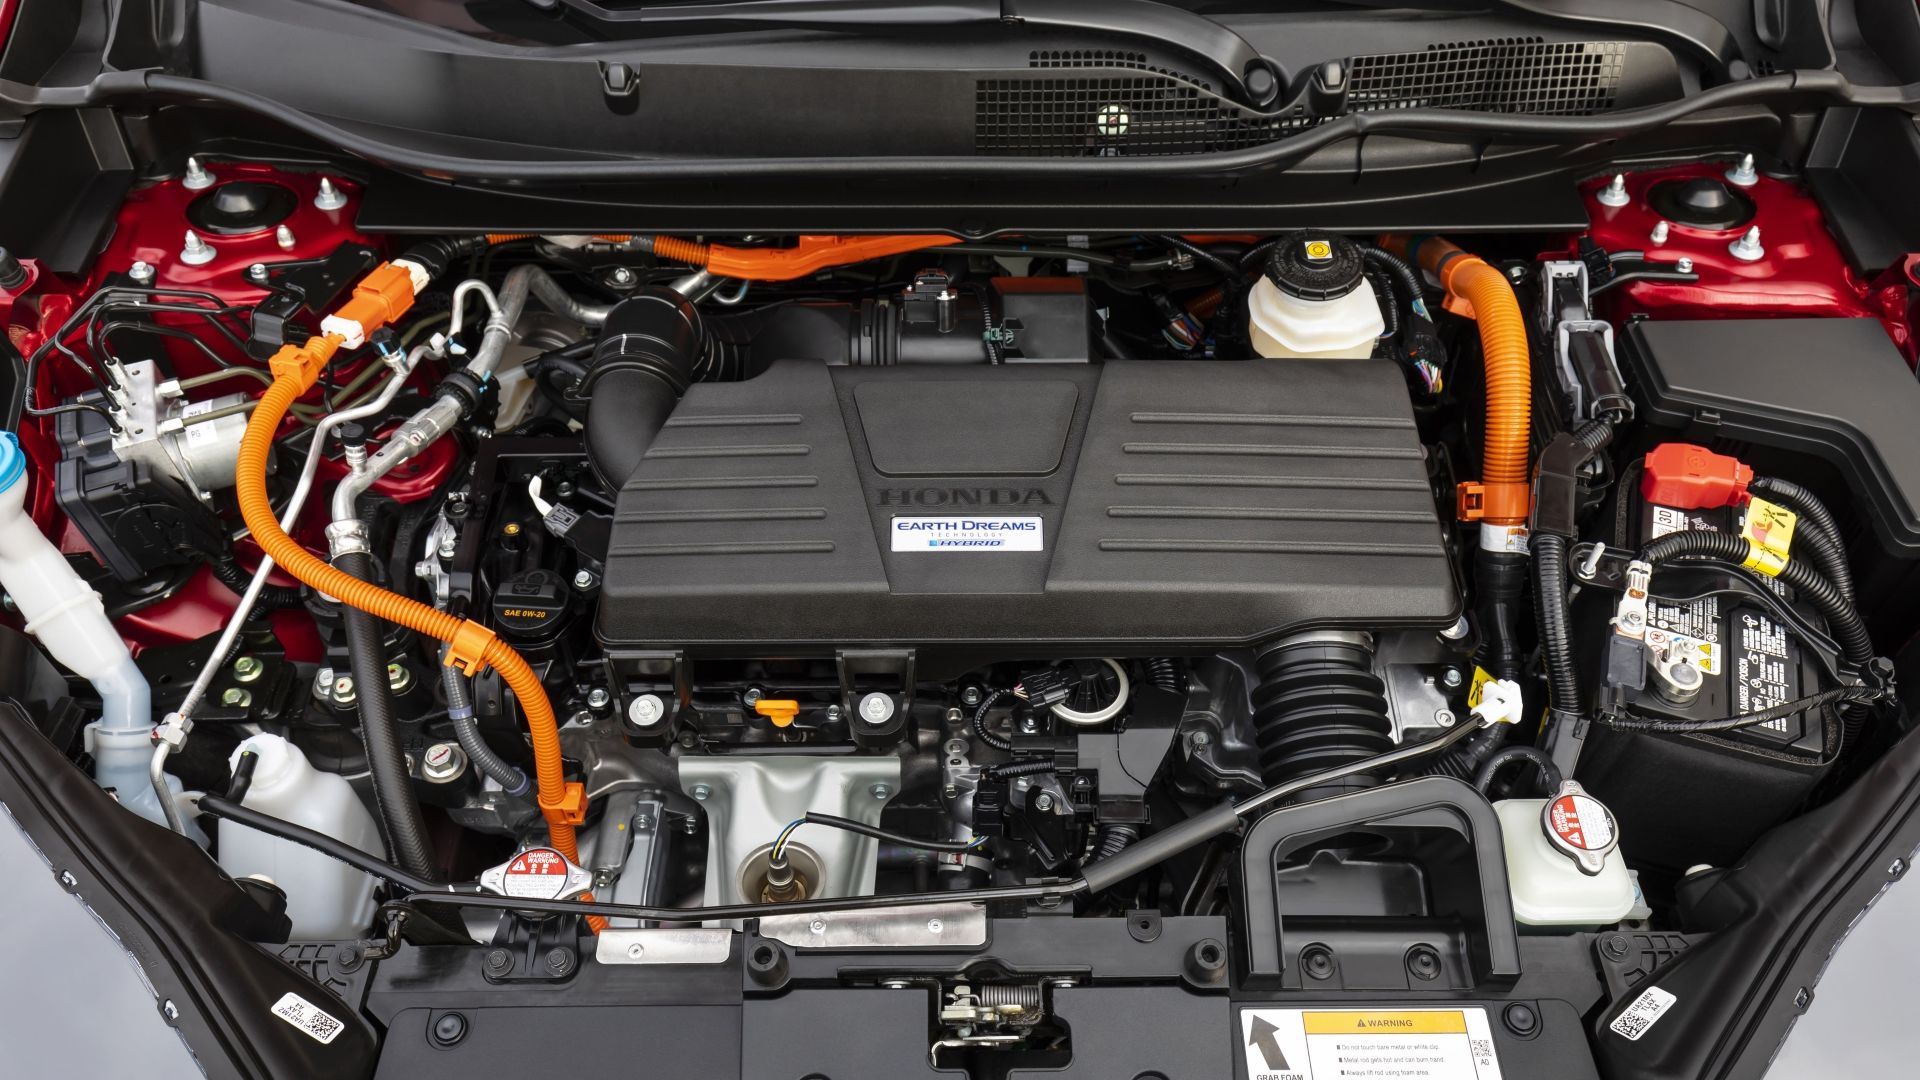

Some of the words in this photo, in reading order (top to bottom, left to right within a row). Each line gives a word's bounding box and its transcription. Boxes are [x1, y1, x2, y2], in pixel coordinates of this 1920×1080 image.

[877, 488, 1056, 506] HONDA
[897, 521, 958, 531] EARTH
[961, 520, 1037, 531] DREAMS
[504, 609, 521, 617] SAE
[522, 610, 546, 618] 0W-20
[1368, 1019, 1413, 1027] WARNING
